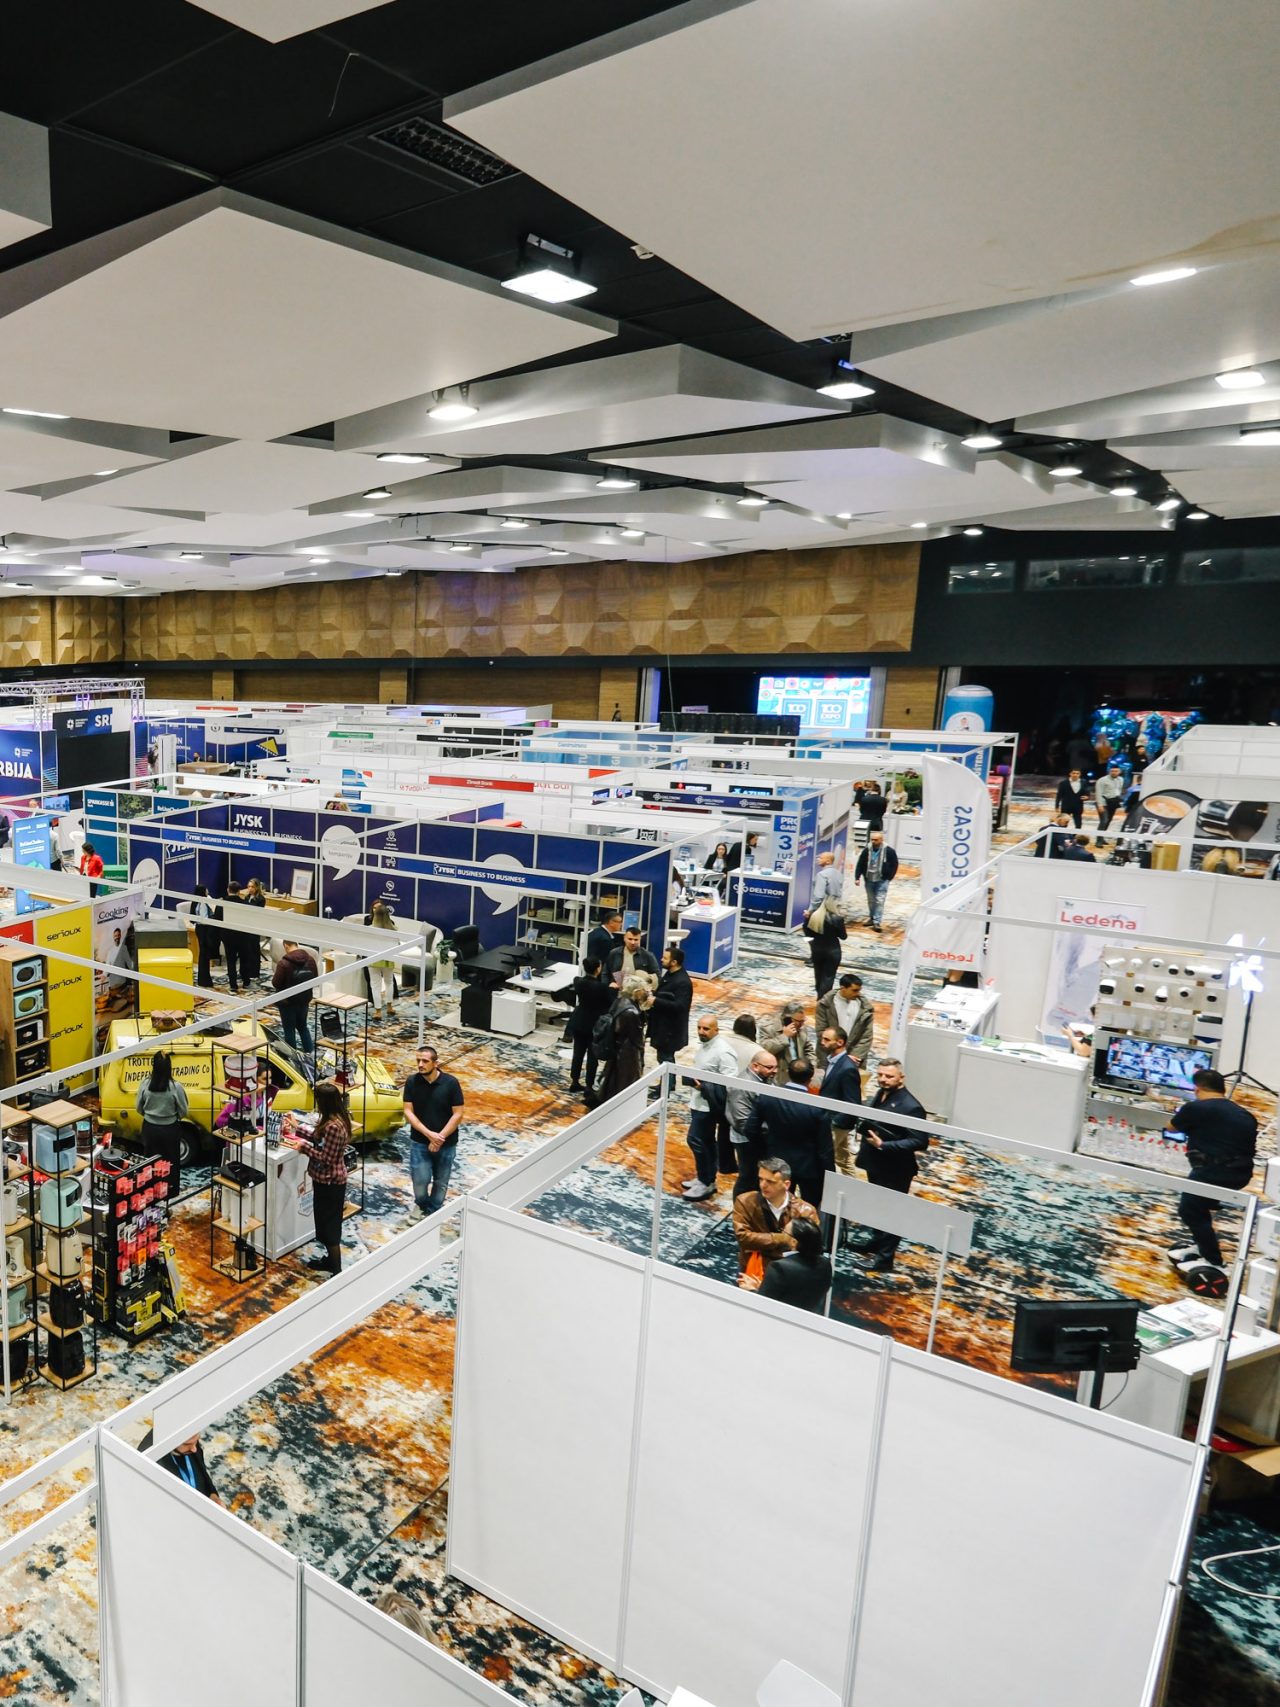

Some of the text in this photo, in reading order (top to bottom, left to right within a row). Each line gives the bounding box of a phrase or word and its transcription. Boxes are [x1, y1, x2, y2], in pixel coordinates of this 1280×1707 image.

[234, 813, 263, 829] JYSK
[778, 835, 792, 850] 3
[439, 866, 455, 875] JYSK
[457, 869, 486, 878] BUSINESS
[496, 874, 526, 883] BUSINESS
[749, 886, 785, 897] DELTRON
[1060, 911, 1137, 931] Ledena
[46, 926, 81, 942] serioux
[48, 975, 82, 991] serioux
[128, 1056, 155, 1067] TROTTE
[124, 1068, 153, 1083] INDEPEN
[172, 1064, 200, 1077] TRADING
